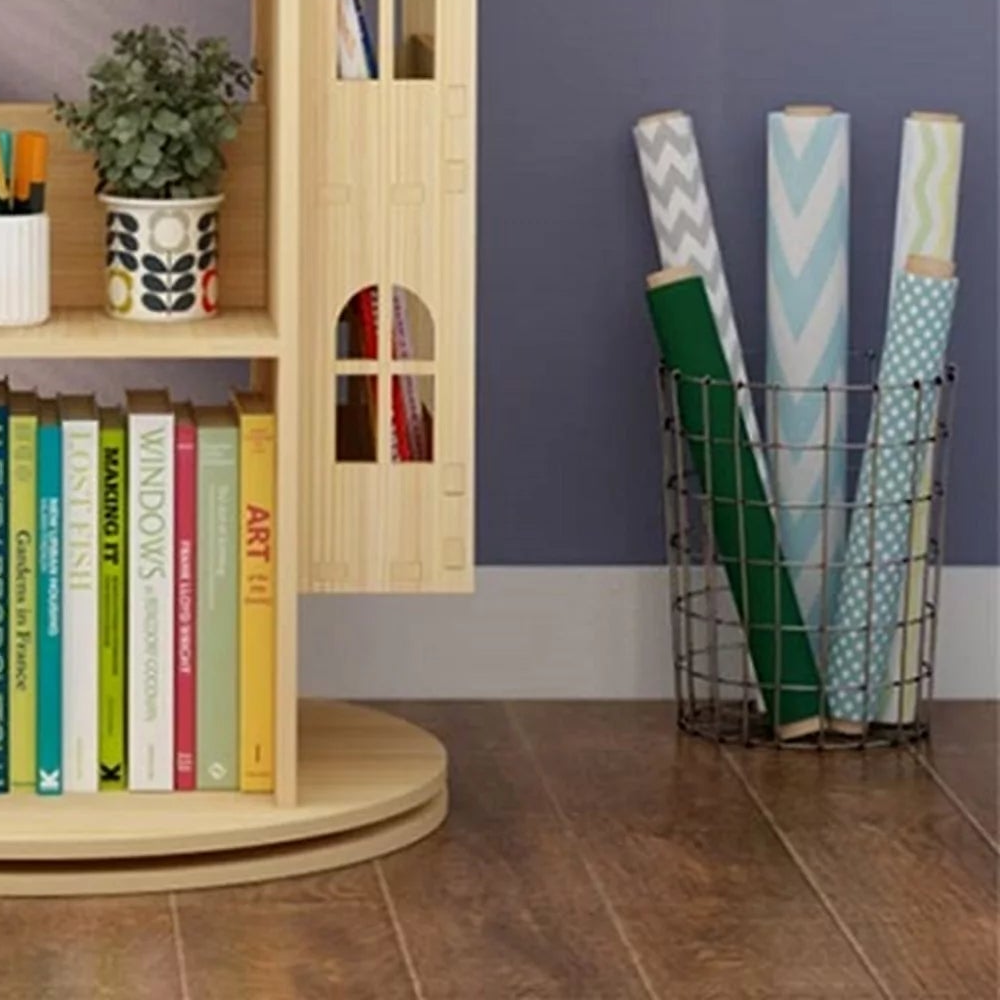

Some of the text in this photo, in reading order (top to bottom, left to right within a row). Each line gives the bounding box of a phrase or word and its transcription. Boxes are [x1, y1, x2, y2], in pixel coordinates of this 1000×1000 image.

[69, 431, 92, 590] LOST FISH
[104, 448, 119, 537] MAKING
[104, 542, 119, 566] IT
[137, 425, 166, 580] WINDOWS
[246, 503, 271, 563] ART
[15, 529, 32, 690] Gardens in France
[179, 540, 193, 674] FRANK LLOYD WRIGHT
